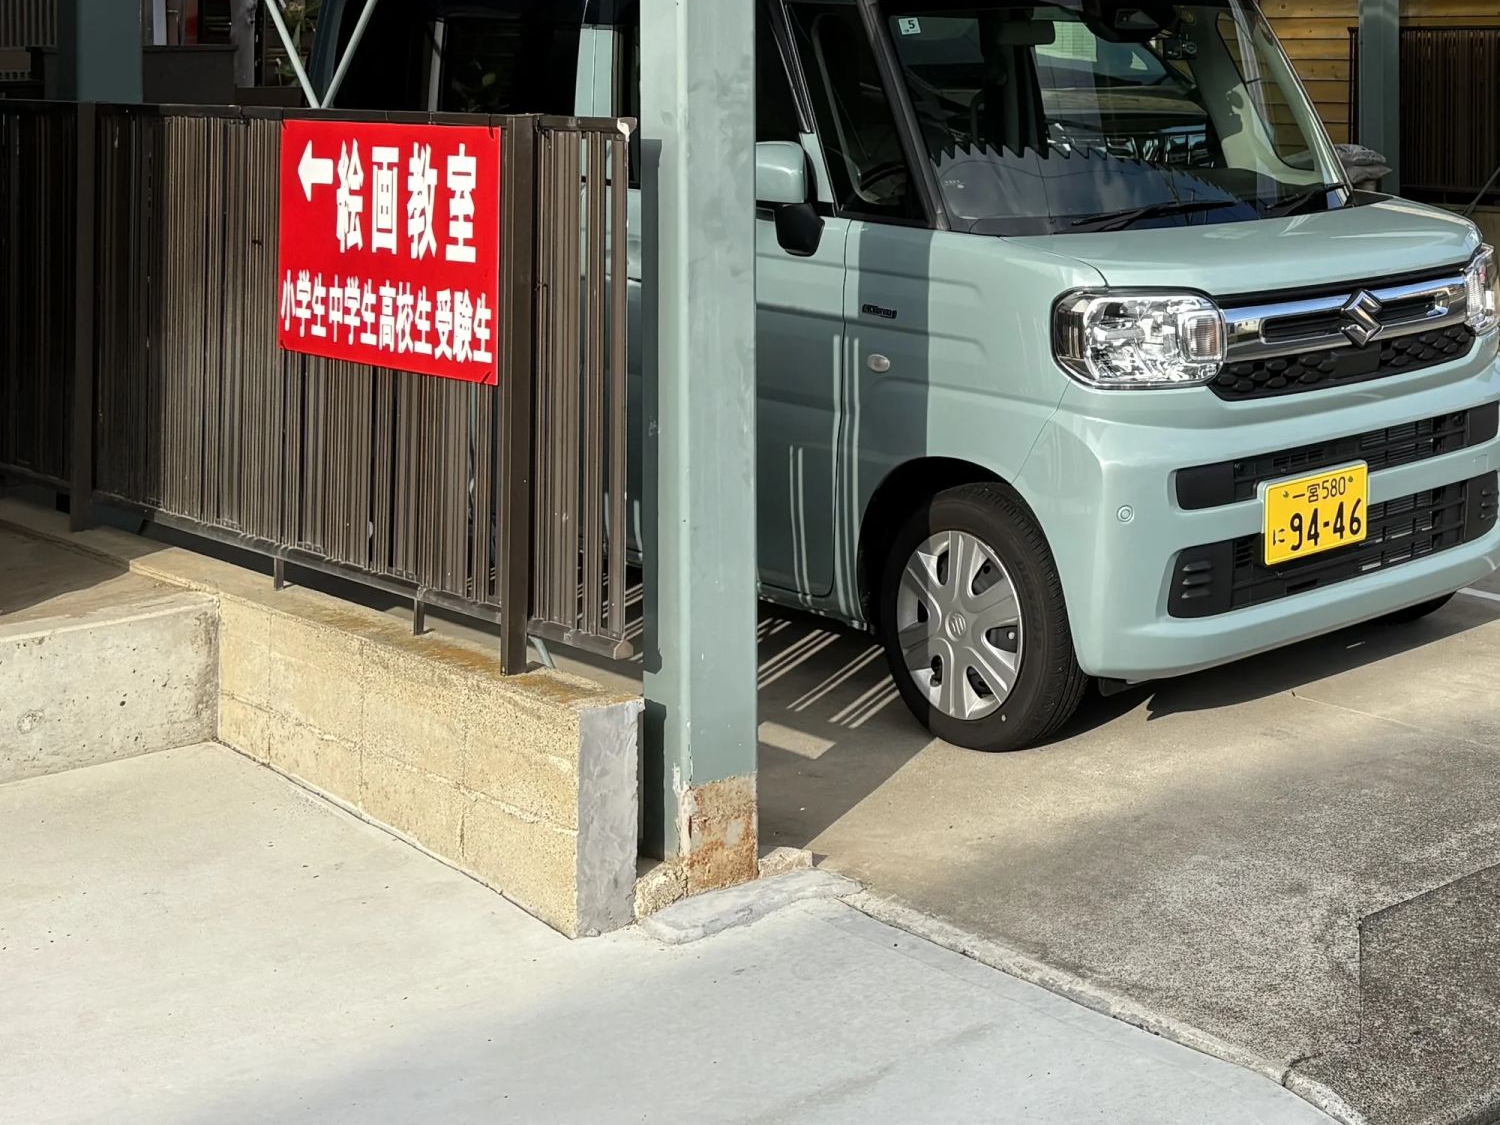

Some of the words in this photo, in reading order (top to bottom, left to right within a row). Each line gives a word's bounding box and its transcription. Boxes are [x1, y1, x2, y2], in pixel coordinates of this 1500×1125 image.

[336, 138, 477, 263] 絵画教室
[280, 269, 493, 364] 小学生中学生高校生受験生
[1289, 497, 1362, 552] 94-46
